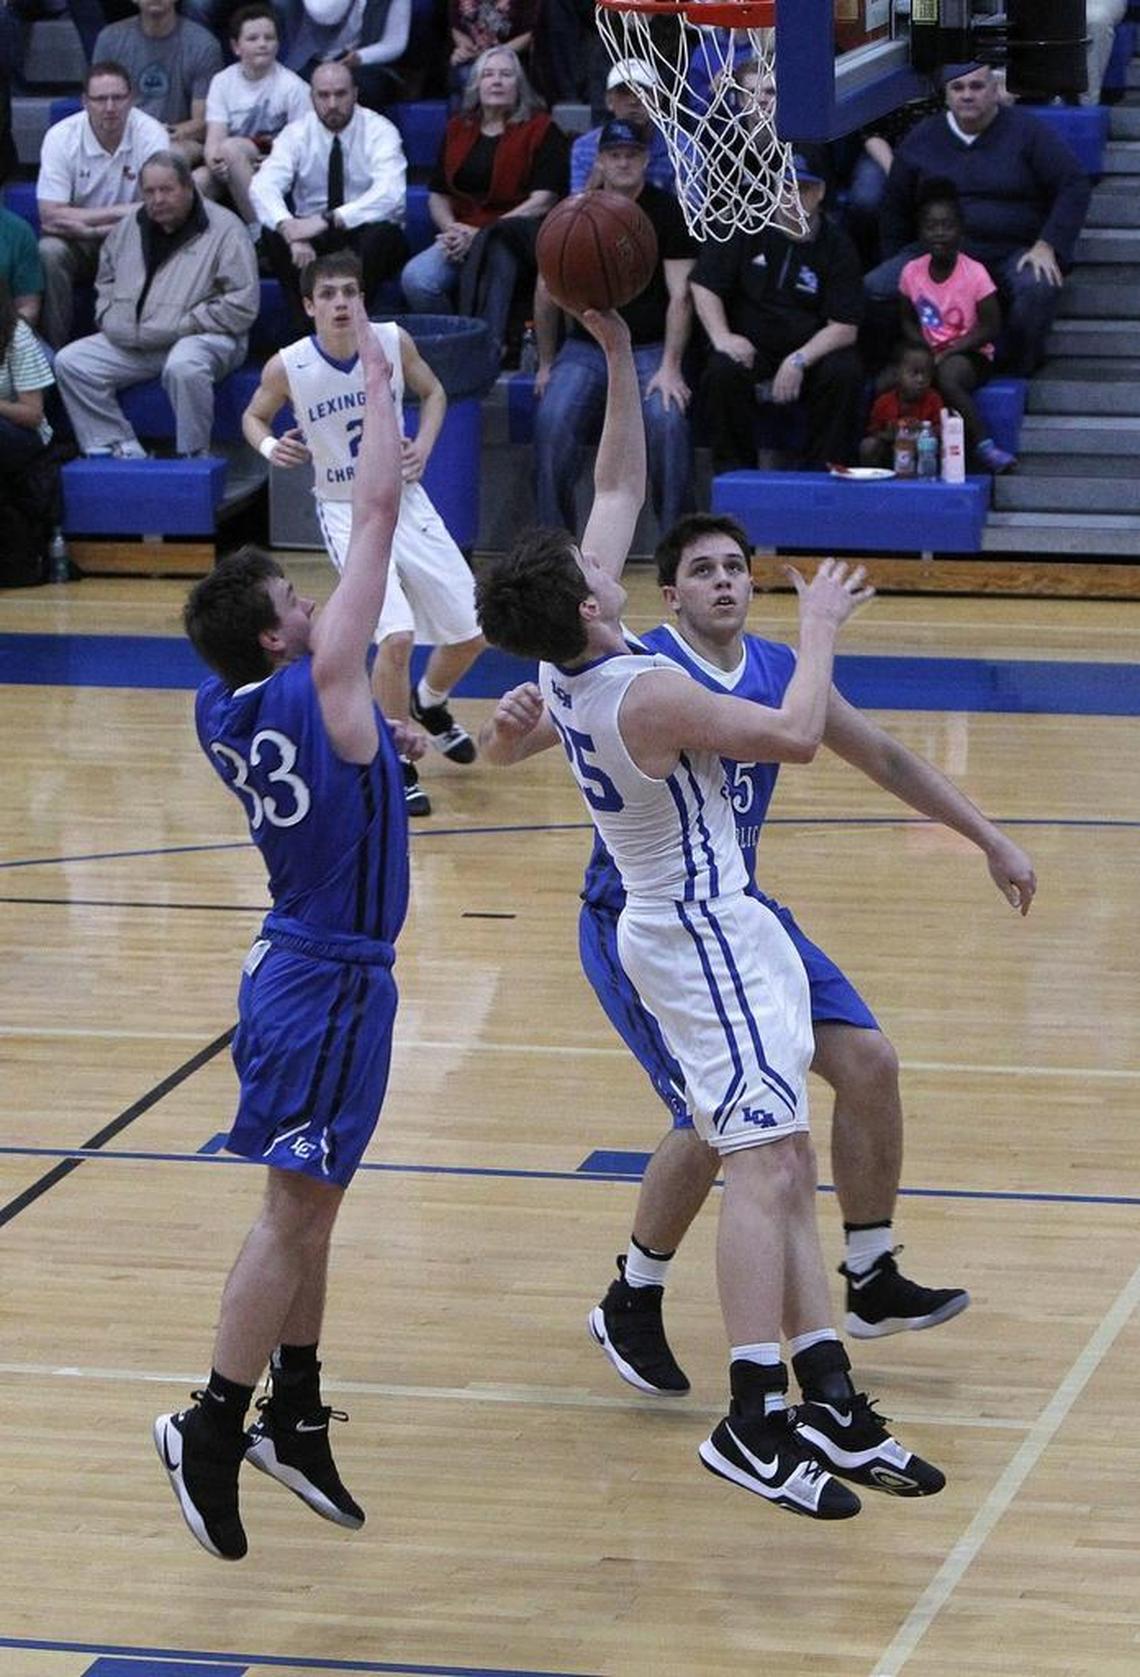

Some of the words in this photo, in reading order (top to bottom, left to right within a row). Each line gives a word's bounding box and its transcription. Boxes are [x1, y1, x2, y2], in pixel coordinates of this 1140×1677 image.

[308, 389, 396, 422] LEXING
[210, 729, 310, 829] 33
[547, 706, 625, 813] 5
[741, 1106, 777, 1129] LCA
